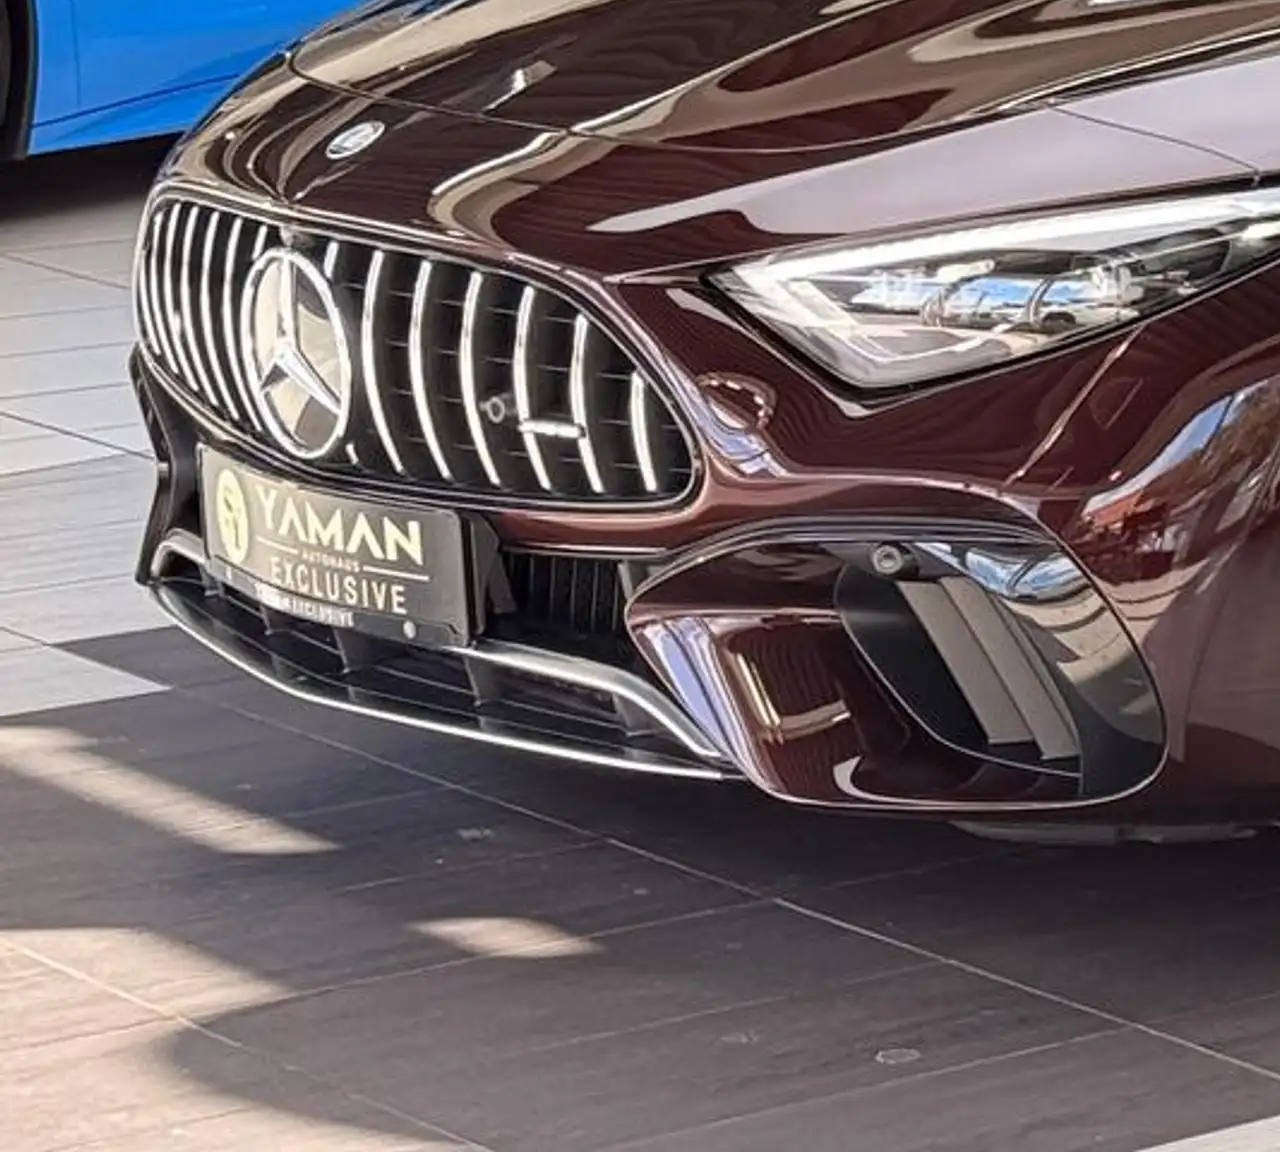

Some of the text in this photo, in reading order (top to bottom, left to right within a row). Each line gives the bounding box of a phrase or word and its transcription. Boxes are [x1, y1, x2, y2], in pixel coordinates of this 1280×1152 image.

[254, 484, 424, 567] YAMAN
[270, 556, 408, 616] EXCLUSIVE
[301, 551, 361, 573] AUTOHAUS
